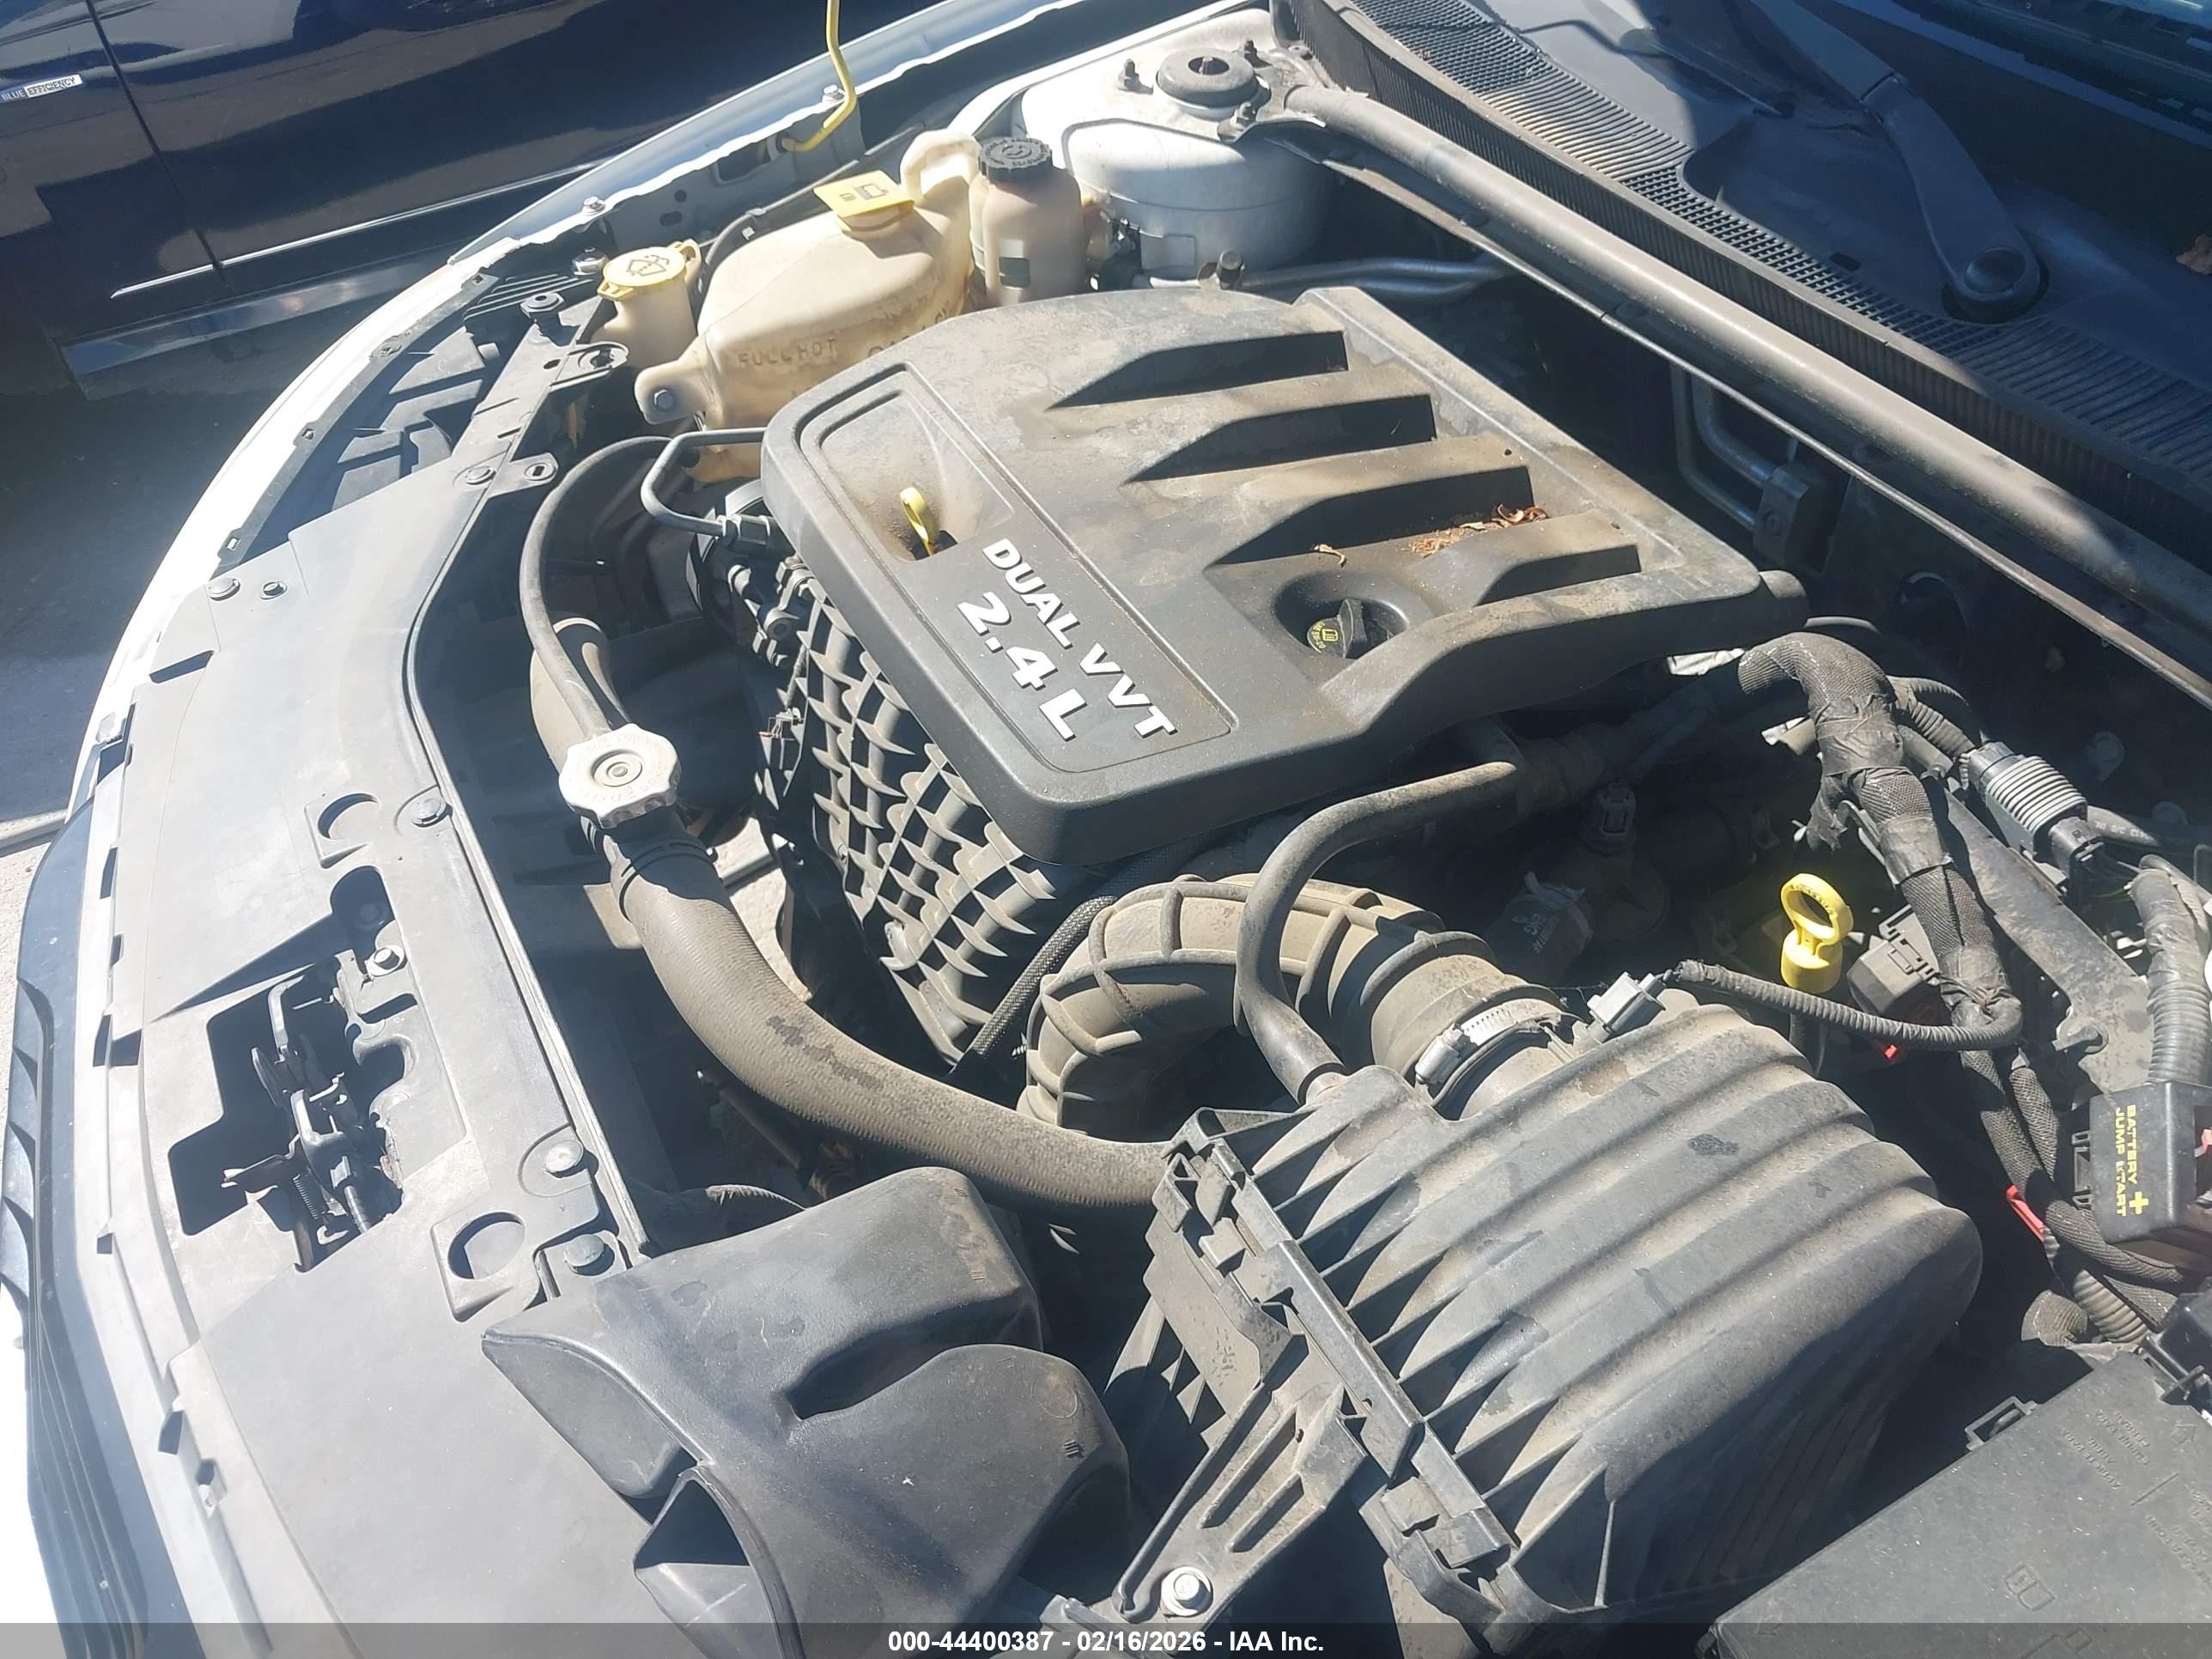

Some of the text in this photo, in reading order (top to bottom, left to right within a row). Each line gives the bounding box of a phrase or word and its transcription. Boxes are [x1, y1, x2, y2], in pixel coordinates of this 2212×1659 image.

[1, 76, 76, 101] BLUE EFFICIENCY
[738, 338, 836, 367] FULL HOT
[957, 592, 1088, 742] 2.4 L
[982, 538, 1178, 738] DUAL VVT
[2116, 1107, 2127, 1217] JUMP START
[2127, 1104, 2137, 1185] BATTERY
